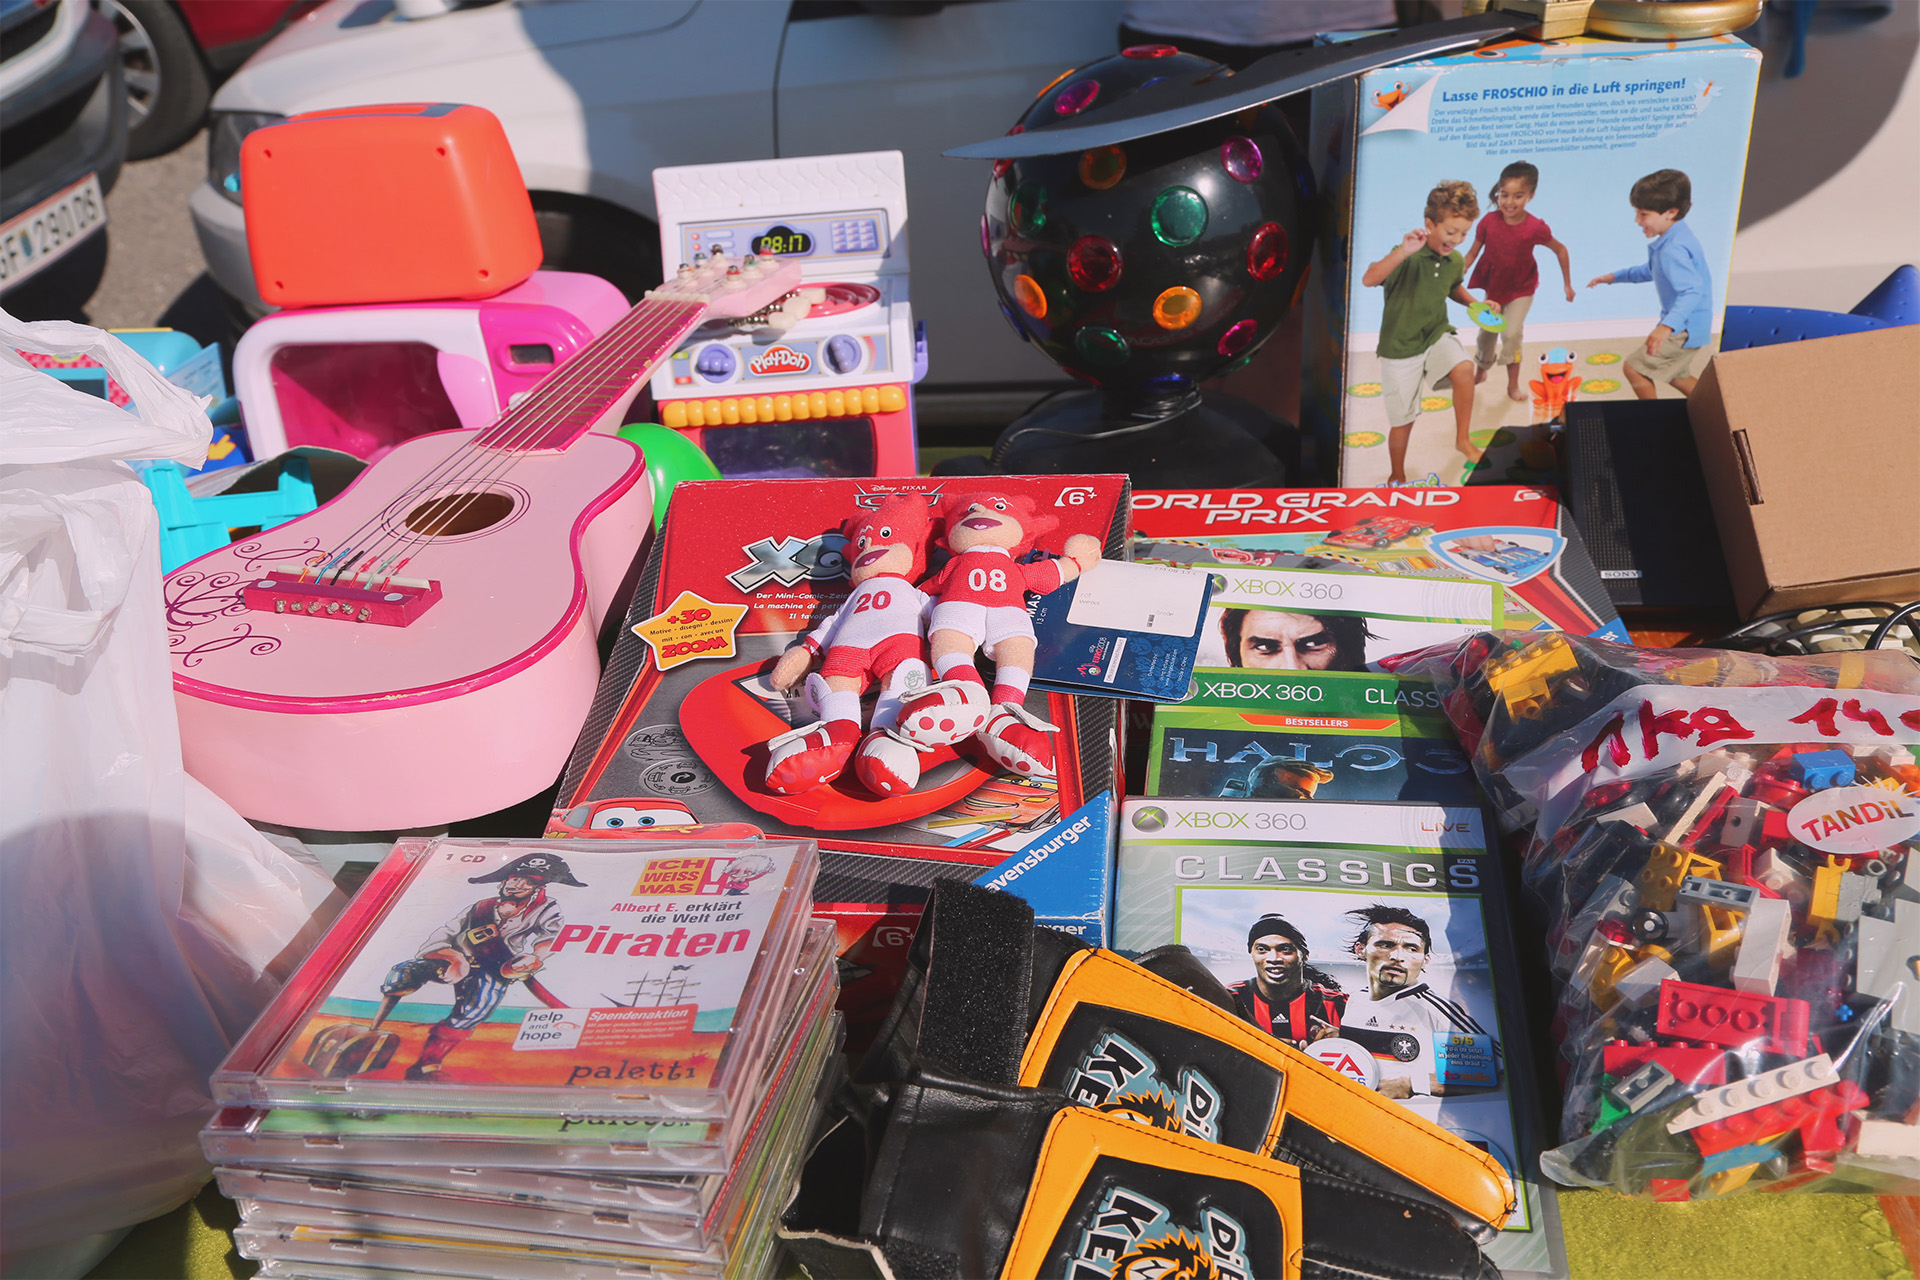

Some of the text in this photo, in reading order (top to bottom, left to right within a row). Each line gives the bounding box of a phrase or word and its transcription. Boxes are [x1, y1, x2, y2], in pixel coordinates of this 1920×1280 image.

[1442, 78, 1686, 102] Lasse FROSCHIO in die Luft springen!
[750, 349, 806, 373] Play-Doh
[1131, 489, 1461, 510] ORLD GRAND
[1205, 508, 1331, 525] PRIX
[968, 568, 1007, 592] 08
[1232, 578, 1344, 600] XBOX 360
[853, 591, 892, 614] 20
[667, 608, 711, 624] +30
[679, 623, 703, 631] disegni
[710, 618, 733, 626] dessins
[661, 636, 728, 658] ZOOM
[1203, 682, 1272, 700] XBOX
[1275, 683, 1323, 702] 360
[1285, 717, 1349, 728] BESTSELLERS
[1169, 736, 1470, 774] HALO 3
[1175, 811, 1471, 833] XBOX 360 LIVE
[446, 853, 487, 863] 1 CD
[984, 815, 1092, 893] avensburger
[648, 859, 706, 870] ICH
[1175, 855, 1480, 889] CLASSICS
[643, 870, 700, 882] WEISS
[610, 900, 743, 913] Albert E. erklärt
[641, 911, 743, 924] die Welt der
[549, 924, 751, 958] Piraten
[528, 1012, 563, 1023] help
[588, 1009, 689, 1021] Spendenaktion
[520, 1031, 562, 1041] hope
[1452, 1035, 1474, 1046] 6/6
[1319, 1052, 1365, 1076] EA
